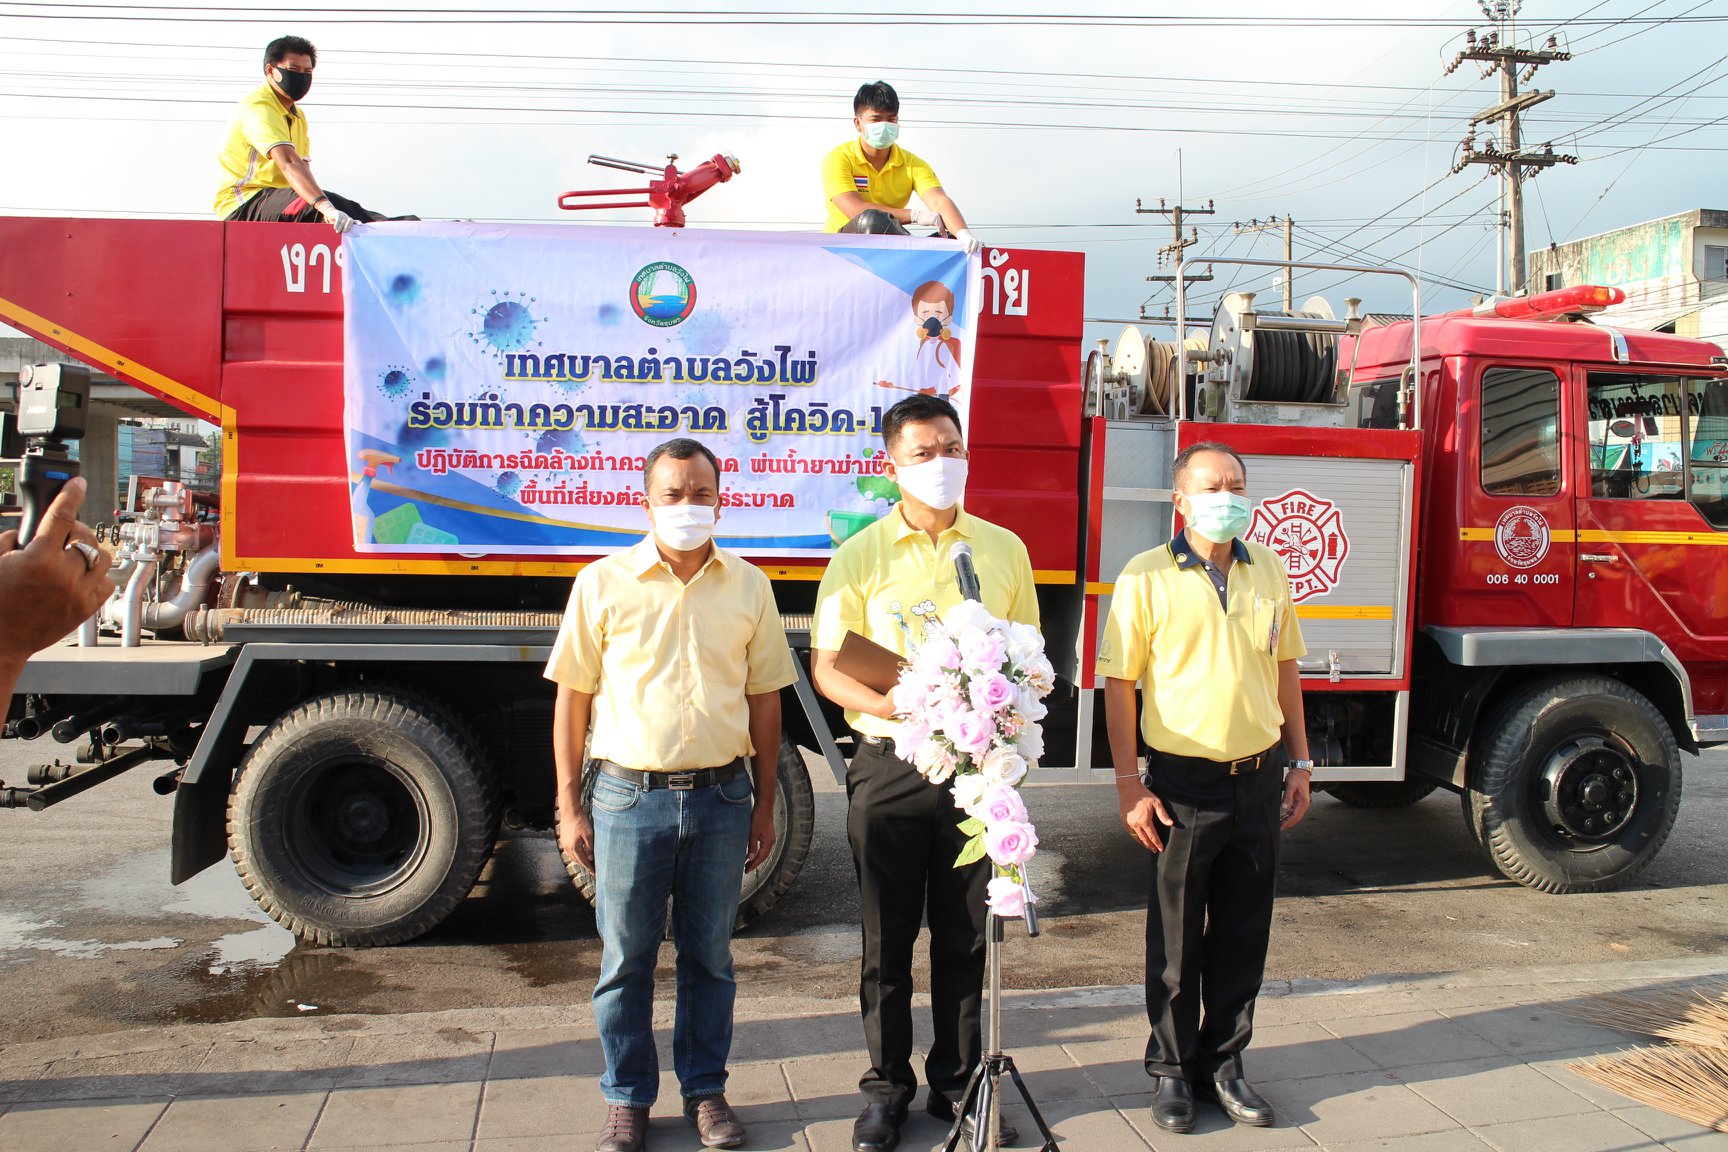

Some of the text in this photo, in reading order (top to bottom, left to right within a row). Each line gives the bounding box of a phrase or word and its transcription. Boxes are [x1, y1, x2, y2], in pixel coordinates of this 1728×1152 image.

[504, 345, 818, 385] เทศบาลตำบลวังไผ่
[409, 392, 882, 440] ร่วมทำความสะอาด สู้โควิด-1
[751, 449, 884, 474] พ่นน้ำยาฆ่าเชื้
[1281, 501, 1316, 517] FIRE
[1289, 578, 1318, 594] EPT.
[1486, 574, 1559, 584] 006 40 0001
